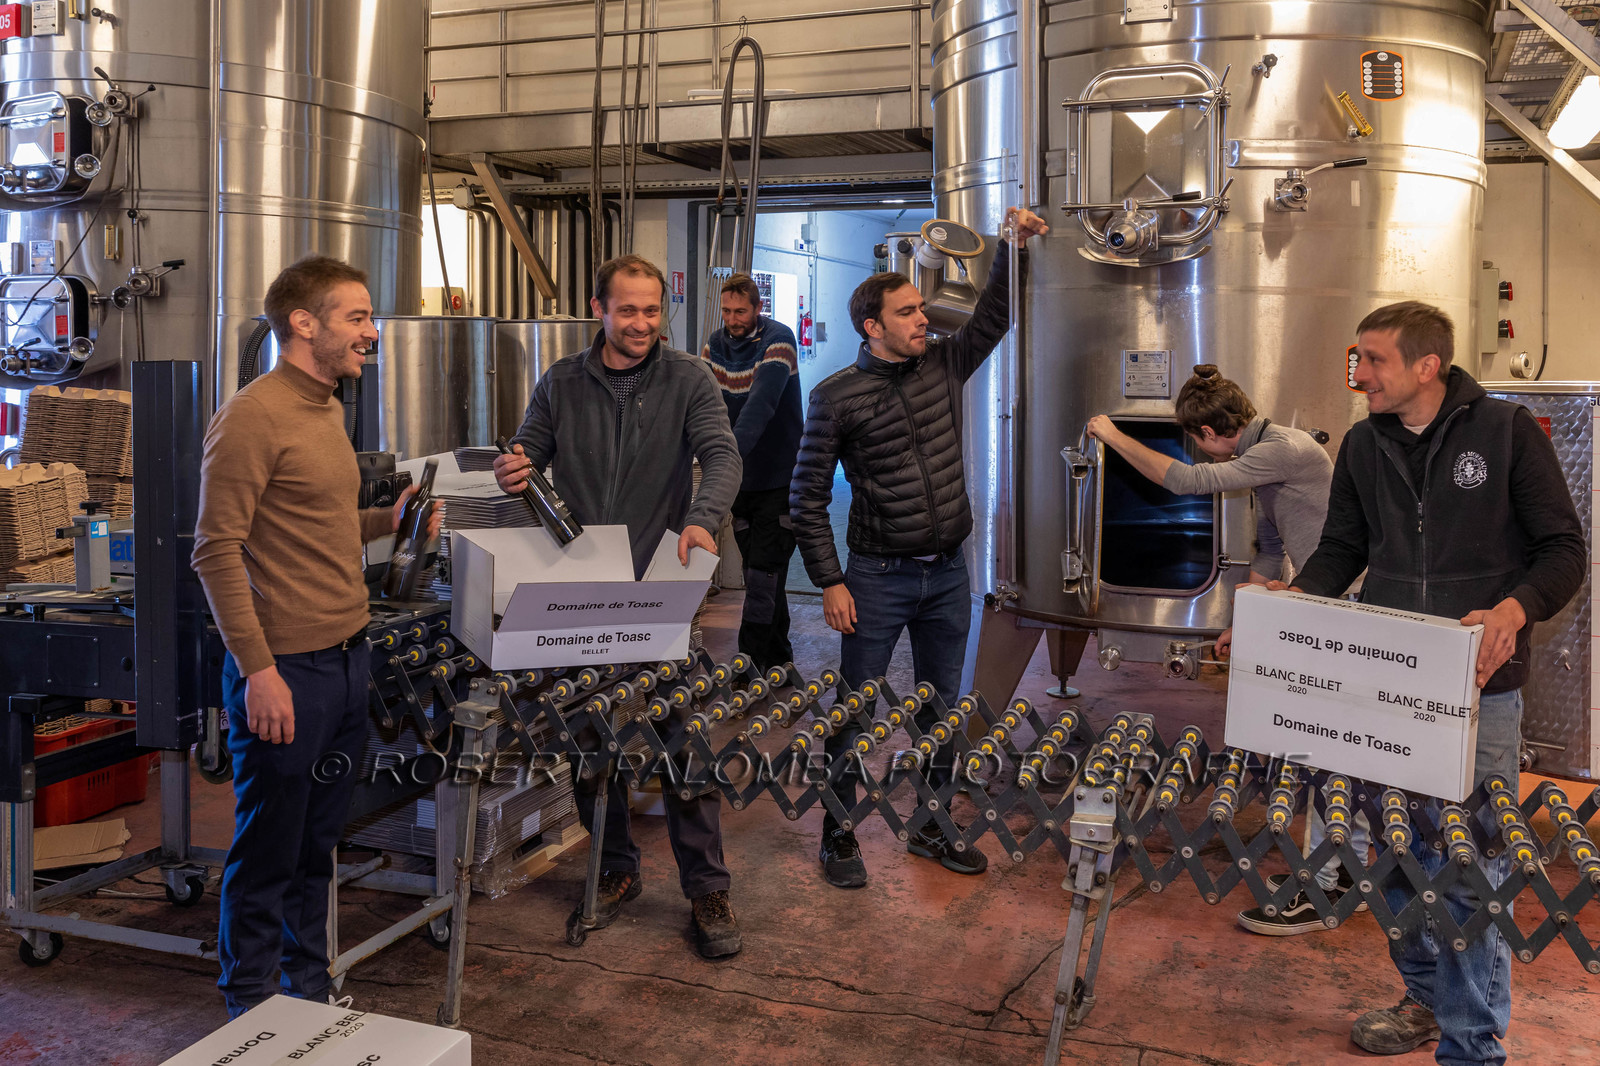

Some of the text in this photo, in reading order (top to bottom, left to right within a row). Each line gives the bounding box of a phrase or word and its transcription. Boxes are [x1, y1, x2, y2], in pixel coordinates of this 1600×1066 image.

[547, 600, 664, 612] Domaine de Toasc
[1356, 606, 1426, 622] Domaine
[536, 631, 651, 647] Domaine de Toasc
[1278, 630, 1418, 669] Domaine de Toasc
[1255, 664, 1342, 692] BLANC BELLET
[1287, 684, 1307, 695] 2020
[1378, 690, 1423, 710] BLANC
[1427, 700, 1472, 719] BELLET
[1413, 711, 1436, 723] 2020
[1273, 713, 1411, 757] Domaine de Toasc
[339, 1022, 365, 1038] 2020
[287, 1027, 340, 1060] BLANC
